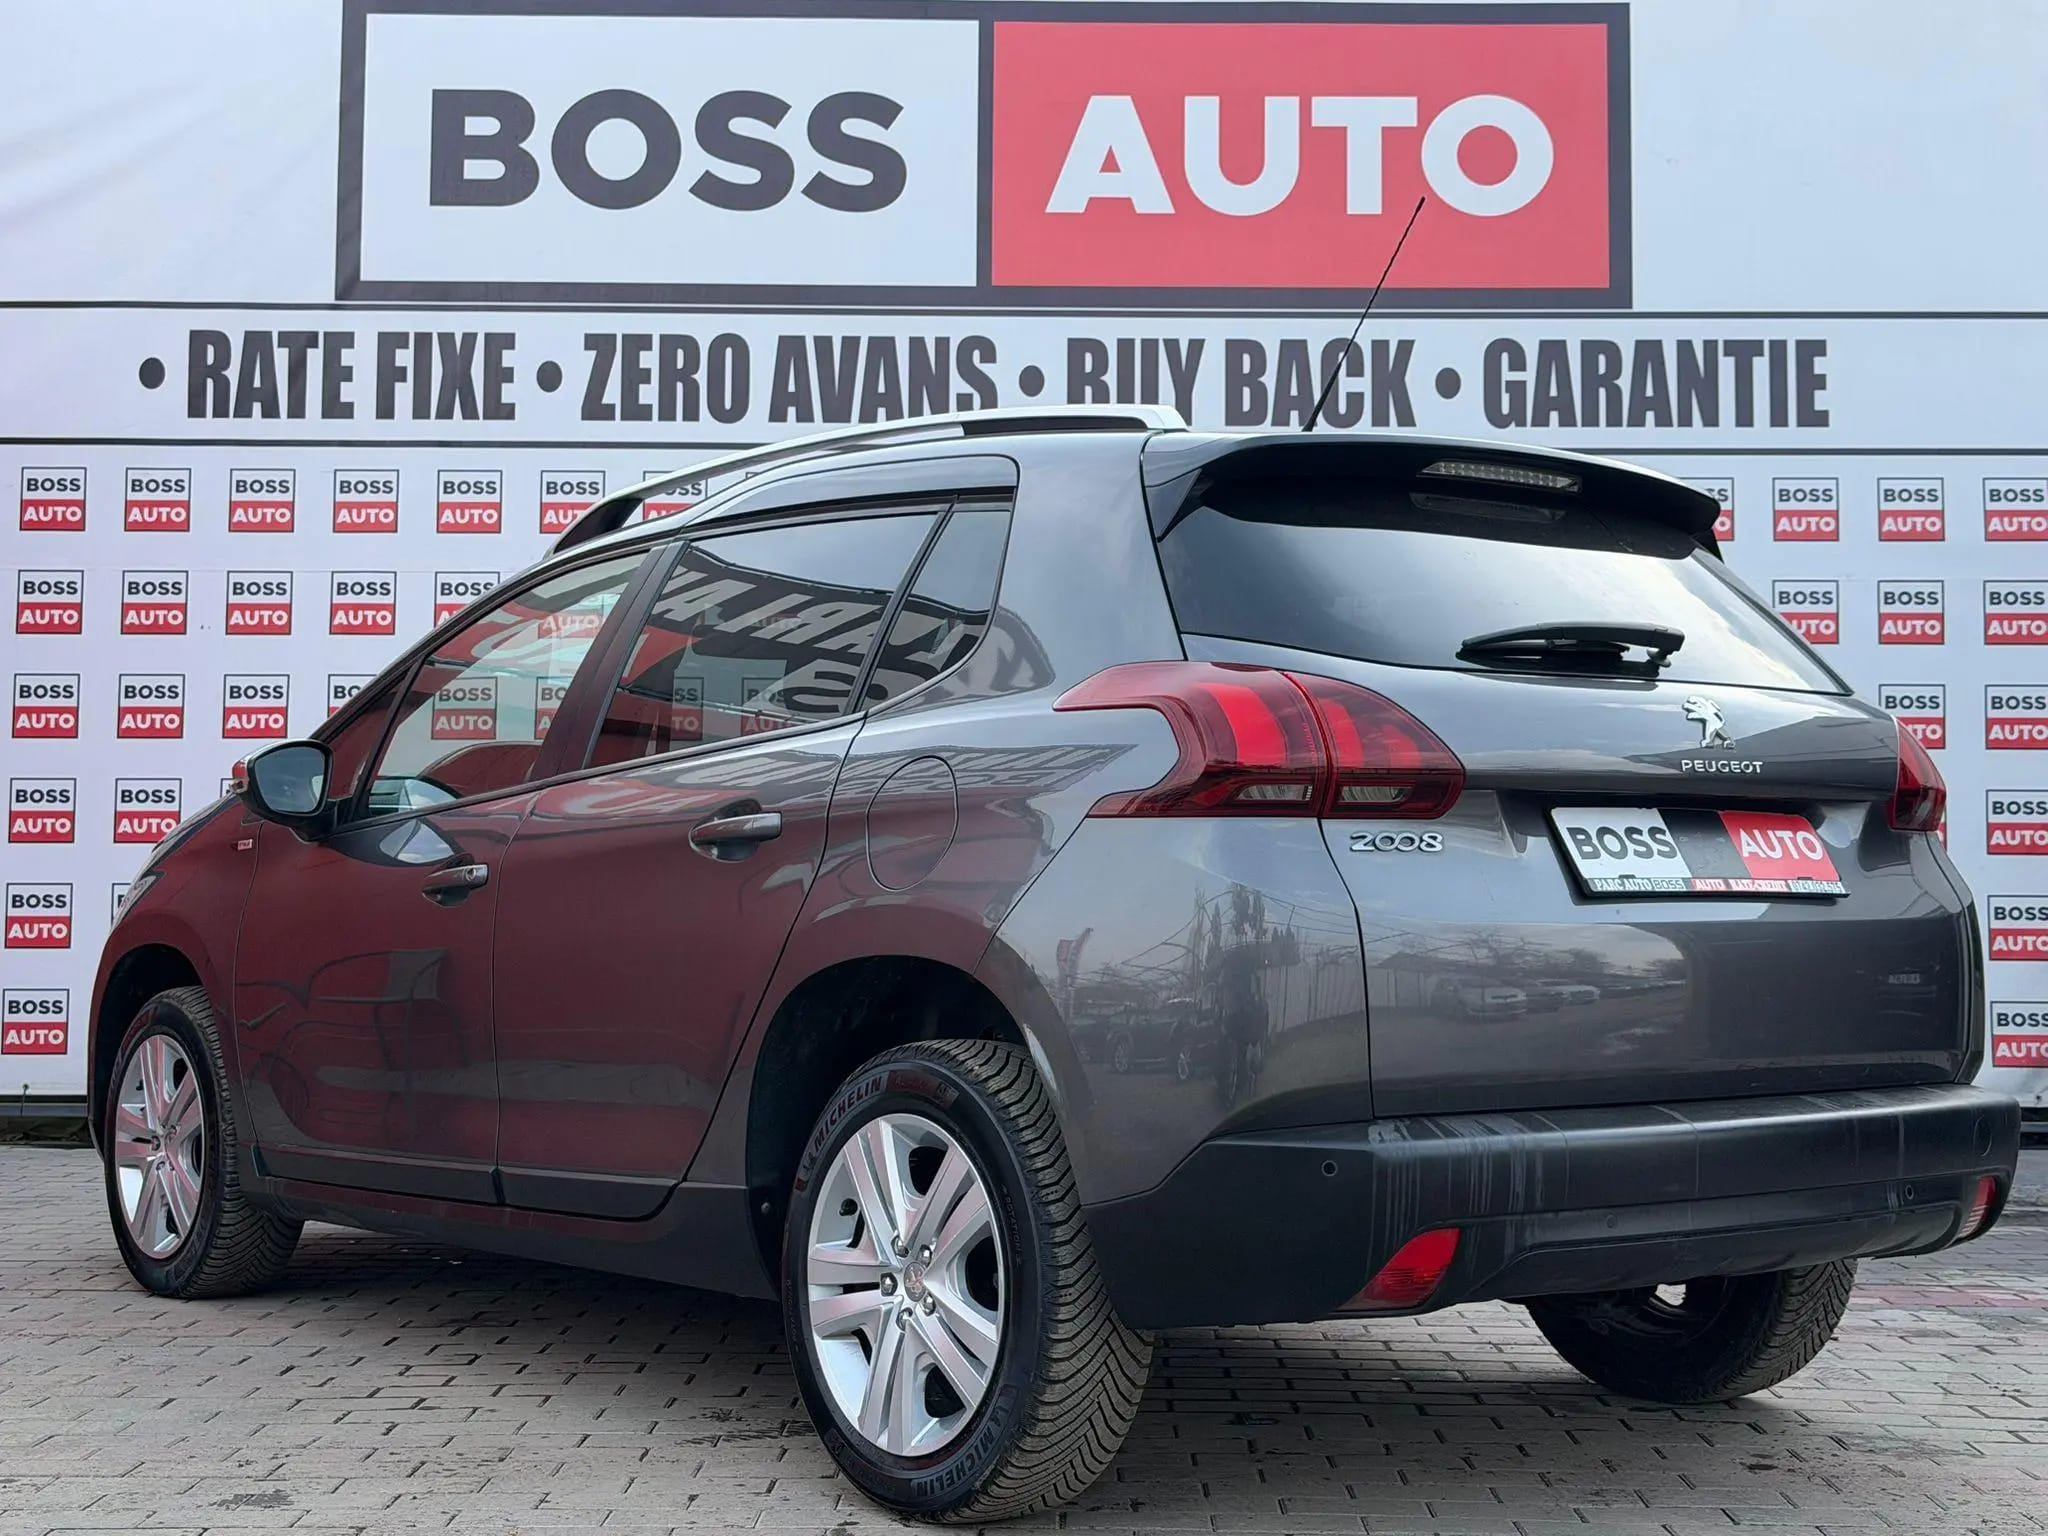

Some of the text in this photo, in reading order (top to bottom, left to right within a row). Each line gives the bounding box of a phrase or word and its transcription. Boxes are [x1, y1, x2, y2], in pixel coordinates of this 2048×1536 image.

[430, 88, 1554, 217] BOSS AUTO
[188, 330, 1830, 429] RATE FIXE ZERO AVANS BUY BACK GARANTIE
[27, 478, 80, 491] BOSS
[131, 479, 185, 492] BOSS
[236, 480, 289, 493] BOSS
[340, 480, 393, 494] BOSS
[443, 481, 496, 494] BOSS
[546, 481, 599, 495] BOSS
[1779, 489, 1833, 502] BOSS
[1884, 489, 1938, 502] BOSS
[1990, 489, 2044, 502] BOSS
[24, 507, 82, 521] AUTO
[128, 507, 187, 522] AUTO
[232, 508, 291, 522] AUTO
[337, 509, 394, 523] AUTO
[440, 509, 499, 523] AUTO
[1777, 517, 1835, 531] AUTO
[1882, 517, 1941, 531] AUTO
[1988, 517, 2048, 531] AUTO
[24, 581, 77, 595] BOSS
[128, 582, 182, 595] BOSS
[233, 582, 286, 595] BOSS
[337, 582, 390, 596] BOSS
[1779, 591, 1833, 605] BOSS
[1884, 592, 1938, 605] BOSS
[1990, 592, 2045, 605] BOSS
[20, 610, 78, 624] AUTO
[124, 610, 183, 625] AUTO
[230, 611, 288, 625] AUTO
[333, 610, 392, 625] AUTO
[1792, 619, 1836, 635] UTO
[1882, 620, 1940, 635] AUTO
[1988, 620, 2047, 635] AUTO
[20, 685, 73, 698] BOSS
[125, 685, 179, 699] BOSS
[230, 686, 283, 699] BOSS
[438, 687, 492, 701] BOSS
[1885, 696, 1939, 709] BOSS
[1992, 696, 2046, 710] BOSS
[16, 714, 74, 728] AUTO
[121, 714, 180, 729] AUTO
[226, 714, 284, 729] AUTO
[435, 715, 493, 730] AUTO
[1989, 725, 2048, 740] AUTO
[1681, 759, 1764, 775] PEUGEOT
[16, 789, 70, 803] BOSS
[121, 790, 175, 803] BOSS
[1993, 801, 2048, 815] BOSS
[12, 818, 71, 833] AUTO
[120, 817, 175, 833] AUTO
[1350, 831, 1444, 853] 2008
[1566, 826, 1823, 860] BOSS AUTO
[1990, 830, 2048, 845] AUTO
[1593, 878, 1622, 891] PARC
[1624, 878, 1652, 891] AUTO
[1653, 879, 1684, 890] BOSS
[12, 894, 66, 908] BOSS
[1994, 907, 2048, 921] BOSS
[8, 924, 67, 938] AUTO
[8, 1000, 63, 1014] BOSS
[5, 1030, 64, 1044] AUTO
[815, 1075, 882, 1153] MICHELIN
[913, 1424, 996, 1497] MICHELIN
